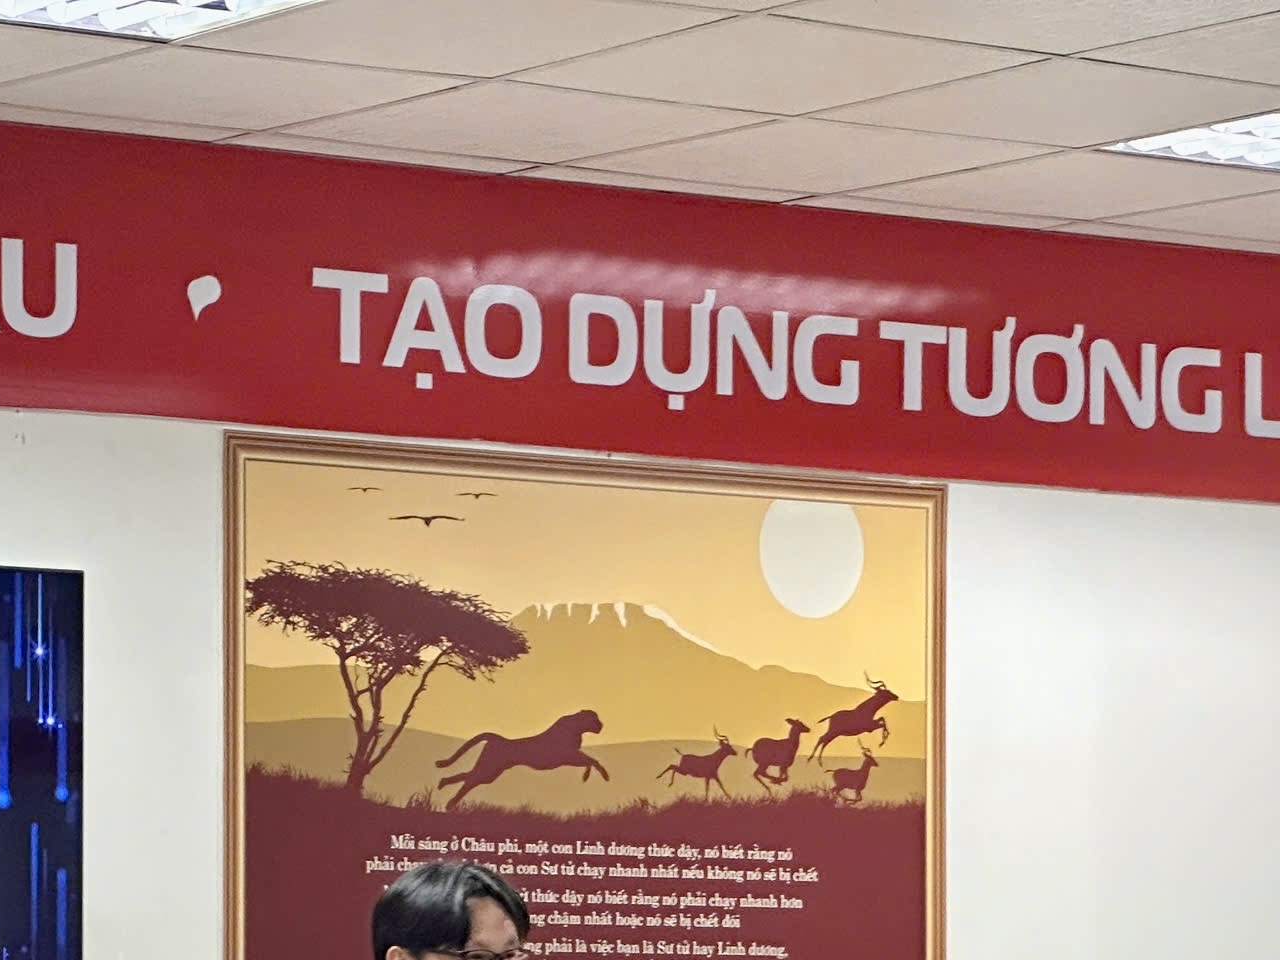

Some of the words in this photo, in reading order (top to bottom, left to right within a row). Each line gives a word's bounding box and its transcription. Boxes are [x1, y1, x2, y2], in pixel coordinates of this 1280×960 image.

[312, 267, 542, 390] TẠO
[569, 289, 860, 410] DỰNG
[880, 316, 1222, 434] TƯƠNG
[390, 833, 415, 850] Mỗi
[418, 837, 449, 854] sáng
[461, 836, 495, 852] Châu
[525, 840, 549, 856] một
[551, 843, 573, 854] con
[576, 840, 605, 855] Linh
[607, 841, 646, 859] dương
[648, 842, 675, 857] thức
[704, 846, 719, 859] nó
[722, 843, 745, 860] biết
[747, 844, 776, 863] rằng
[777, 848, 793, 861] nó
[365, 856, 395, 874] phải
[500, 859, 514, 874] cả
[516, 864, 538, 875] con
[541, 861, 559, 875] Sư
[560, 861, 575, 876] tử
[577, 862, 607, 879] chạy
[609, 863, 648, 878] nhanh
[650, 863, 679, 879] nhất
[682, 863, 704, 879] nếu
[706, 865, 744, 883] không
[746, 868, 762, 881] nó
[778, 867, 791, 884] bị
[792, 867, 819, 882] chết
[531, 889, 559, 903] thức
[587, 890, 602, 904] nó
[604, 889, 629, 905] biết
[631, 889, 660, 908] rằng
[662, 892, 677, 906] nó
[679, 891, 707, 909] phải
[708, 893, 737, 910] chạy
[739, 894, 778, 908] nhanh
[780, 894, 803, 909] hơn
[584, 911, 612, 926] nhất
[615, 911, 644, 929] hoặc
[646, 913, 662, 927] nó
[679, 913, 691, 930] bị
[693, 912, 720, 928] chết
[545, 937, 572, 955] phải
[575, 938, 587, 953] là
[590, 939, 614, 956] việc
[617, 940, 640, 956] bạn
[642, 939, 654, 954] là
[657, 940, 674, 955] Sư
[676, 940, 690, 955] tử
[693, 941, 715, 957] hay
[718, 941, 746, 956] Linh
